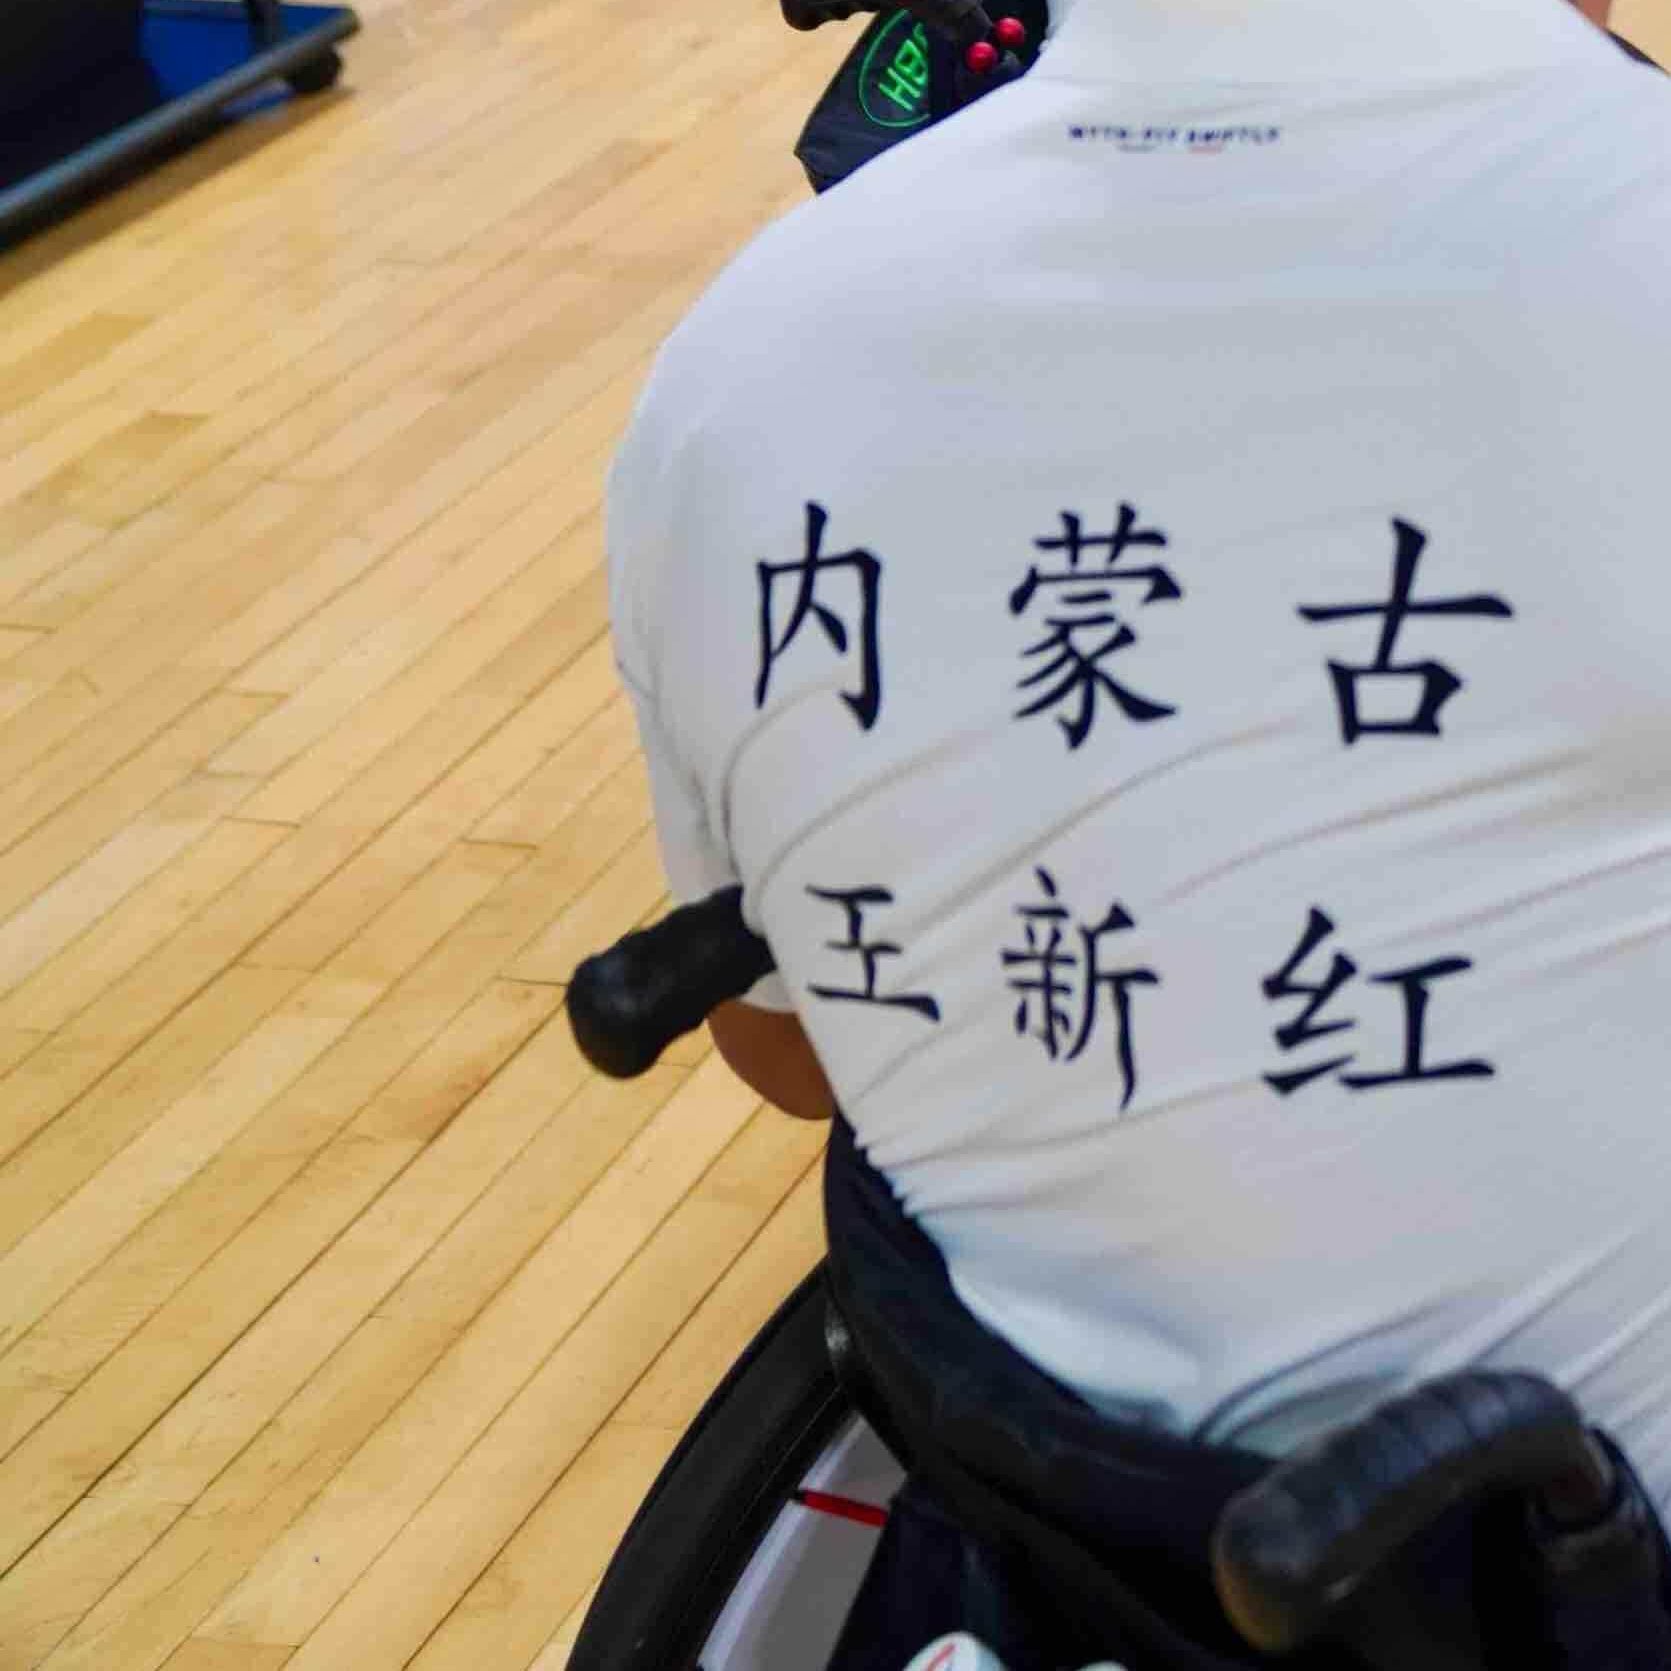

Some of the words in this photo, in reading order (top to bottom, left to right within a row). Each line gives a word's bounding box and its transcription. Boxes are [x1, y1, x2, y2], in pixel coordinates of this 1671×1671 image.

[754, 500, 1514, 750] 内蒙古
[804, 866, 1495, 1112] 王新红
